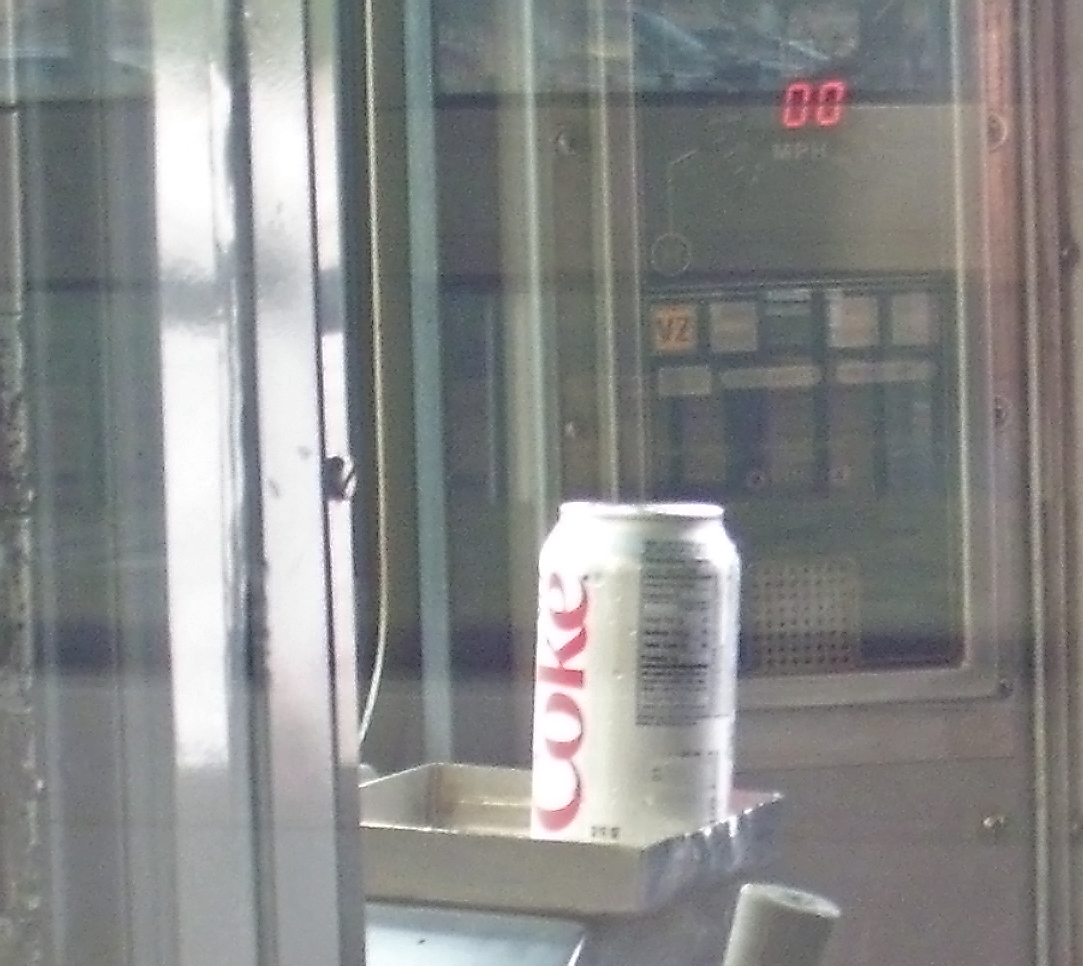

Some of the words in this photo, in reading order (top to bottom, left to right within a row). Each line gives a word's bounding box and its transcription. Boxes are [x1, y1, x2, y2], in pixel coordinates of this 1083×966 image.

[781, 80, 846, 128] 00
[771, 142, 828, 160] MPH
[536, 571, 590, 833] Coke
